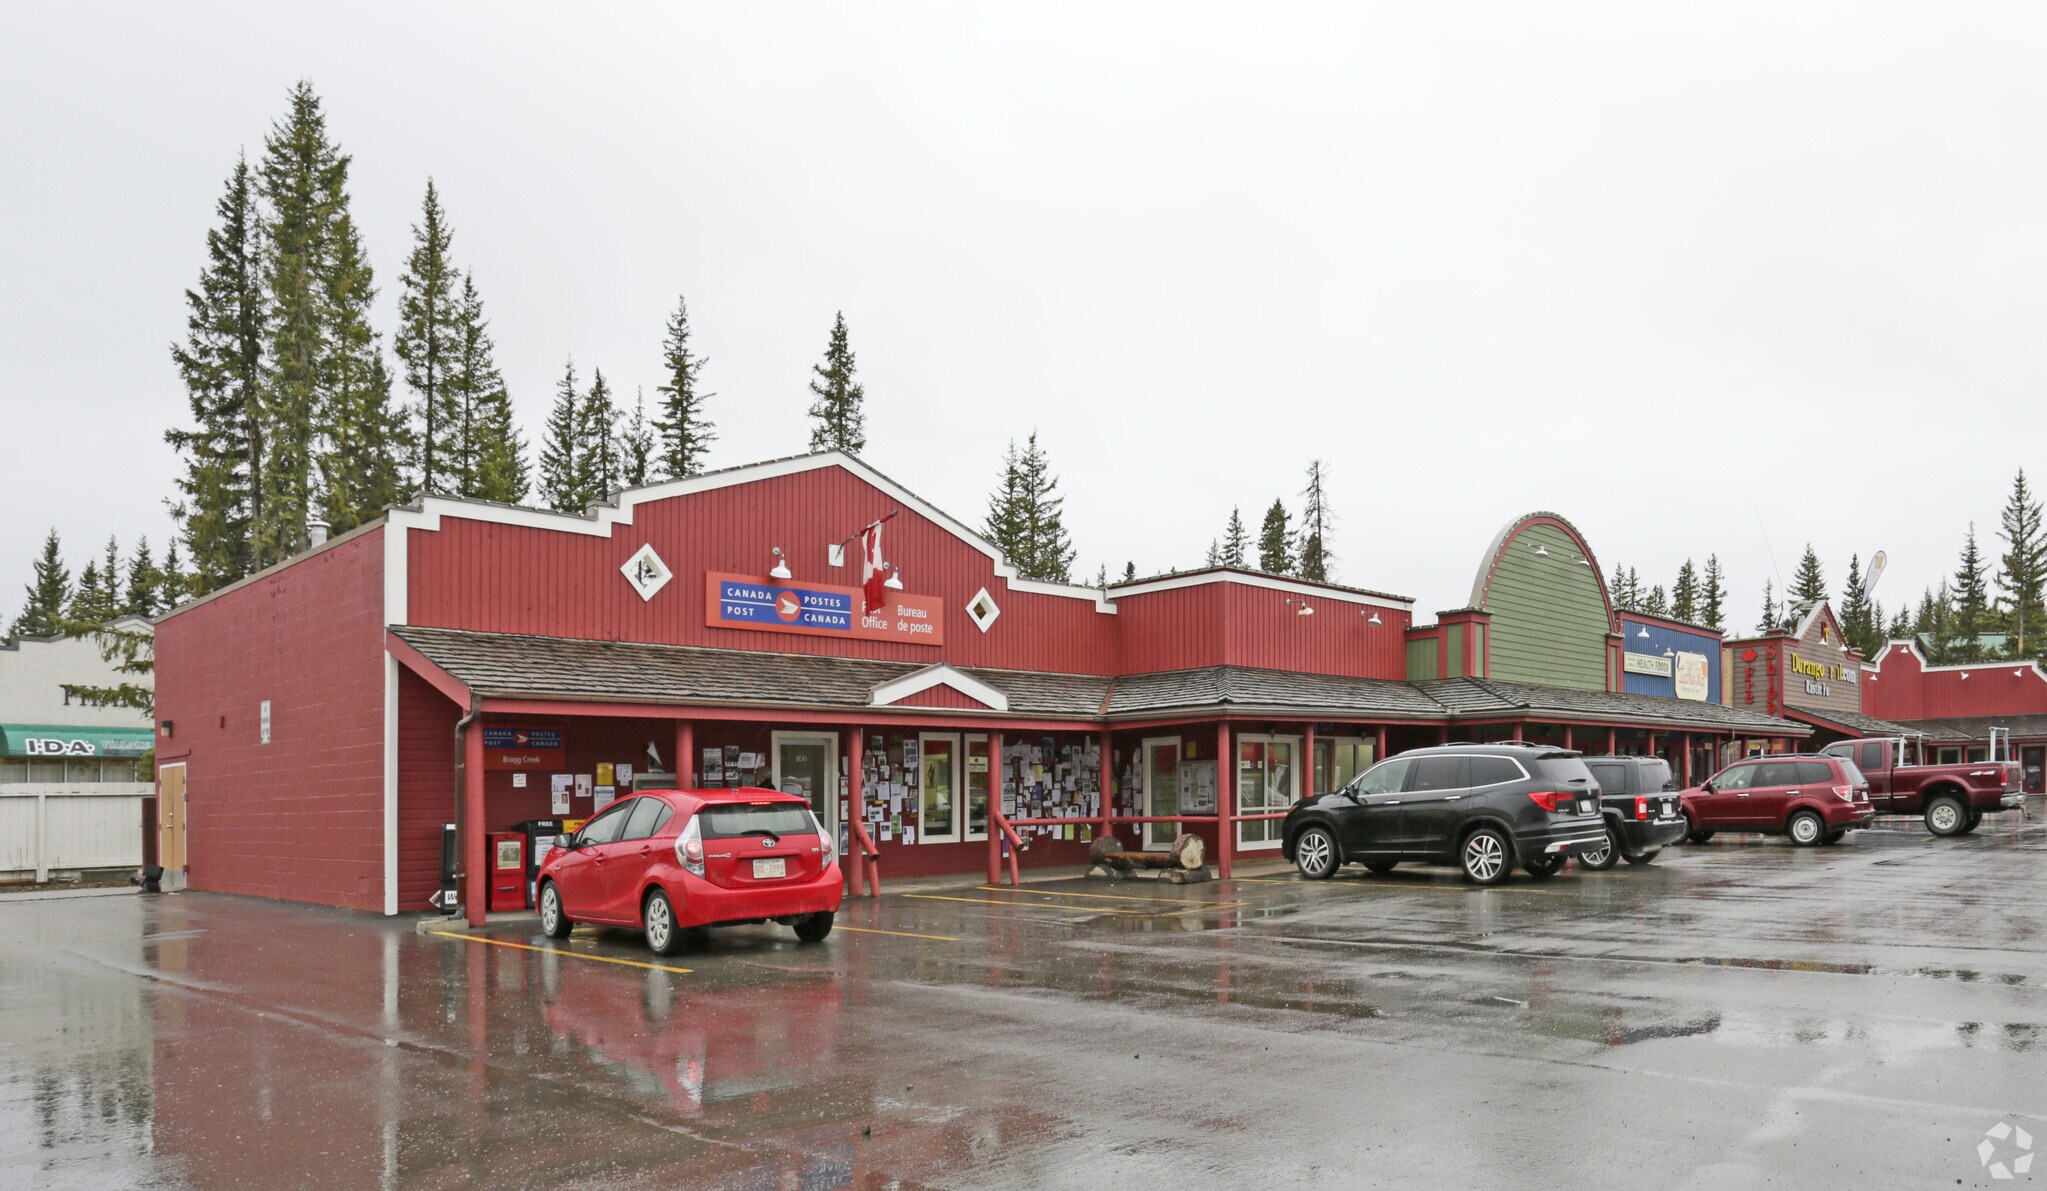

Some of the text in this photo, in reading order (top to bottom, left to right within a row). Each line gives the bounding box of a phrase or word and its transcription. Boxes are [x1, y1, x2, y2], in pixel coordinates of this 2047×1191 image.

[727, 588, 772, 600] CANADA
[804, 596, 840, 607] POSTES
[727, 606, 754, 616] POST
[897, 604, 927, 618] Bureau
[804, 614, 845, 625] CANADA
[861, 616, 887, 629] Office
[897, 619, 933, 635] de poste
[1637, 657, 1654, 671] HEALTH
[1655, 660, 1669, 673] FOODS
[1791, 652, 1825, 681] Durango
[502, 755, 540, 765] Bragg Creek
